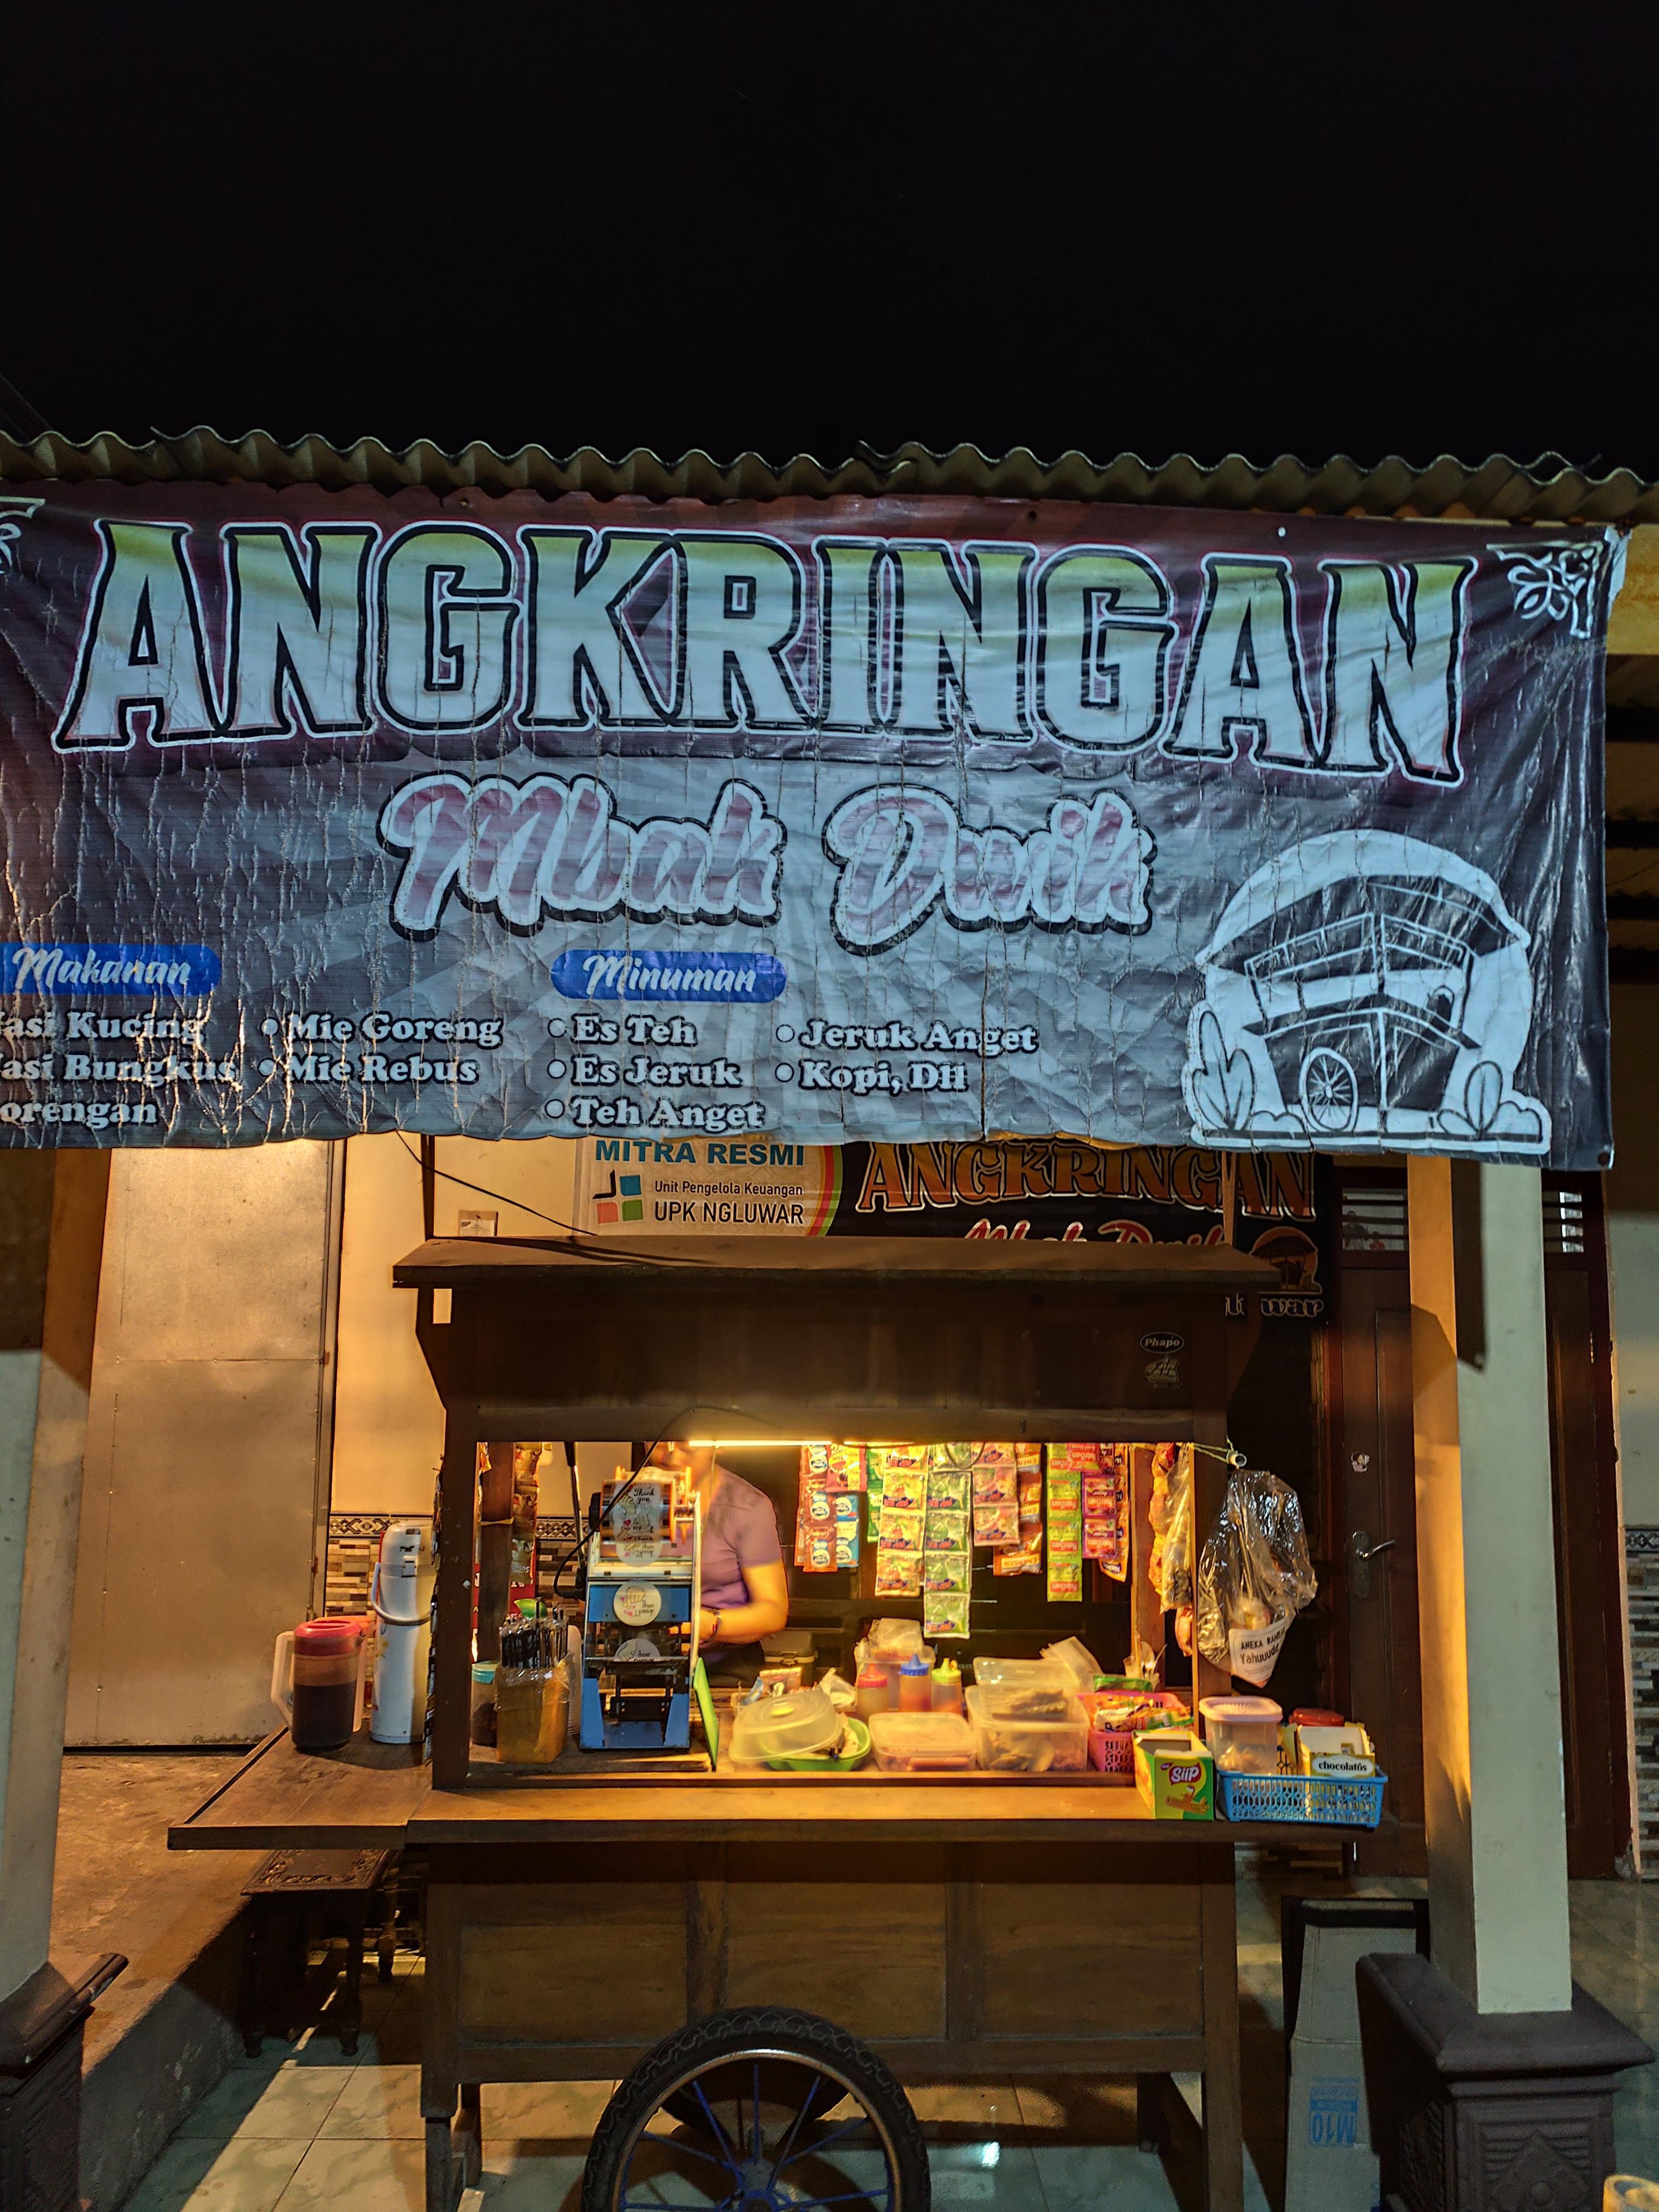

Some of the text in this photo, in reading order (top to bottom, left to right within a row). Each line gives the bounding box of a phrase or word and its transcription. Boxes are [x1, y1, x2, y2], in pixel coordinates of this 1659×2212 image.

[52, 519, 1477, 787] ANGKRINGAN
[377, 771, 787, 940] Mbak
[12, 948, 191, 990] Makanan
[582, 954, 757, 995] Minuman
[0, 1011, 205, 1045] asi Kucing
[285, 1011, 503, 1050] Mie Goreng
[571, 1013, 698, 1047] Es Teh
[799, 1018, 1040, 1059] Jeruk Anget
[0, 1053, 236, 1088] asi Bungkus
[286, 1052, 479, 1085] Mie Rebus
[570, 1053, 743, 1088] Es Jeruk
[799, 1059, 901, 1097] Kopi,
[0, 1102, 157, 1129] orengan
[570, 1095, 766, 1133] Teh Anget
[596, 1140, 804, 1166] MITRA RESMI
[655, 1180, 803, 1198] Unit Pengelola Keuangan
[856, 1142, 1316, 1221] ANGKRINGAN
[654, 1201, 804, 1224] UPK NGLUWAR
[634, 1488, 654, 1497] Thank
[1004, 1557, 1038, 1567] ENERGEN
[1241, 1639, 1264, 1650] ANEKA
